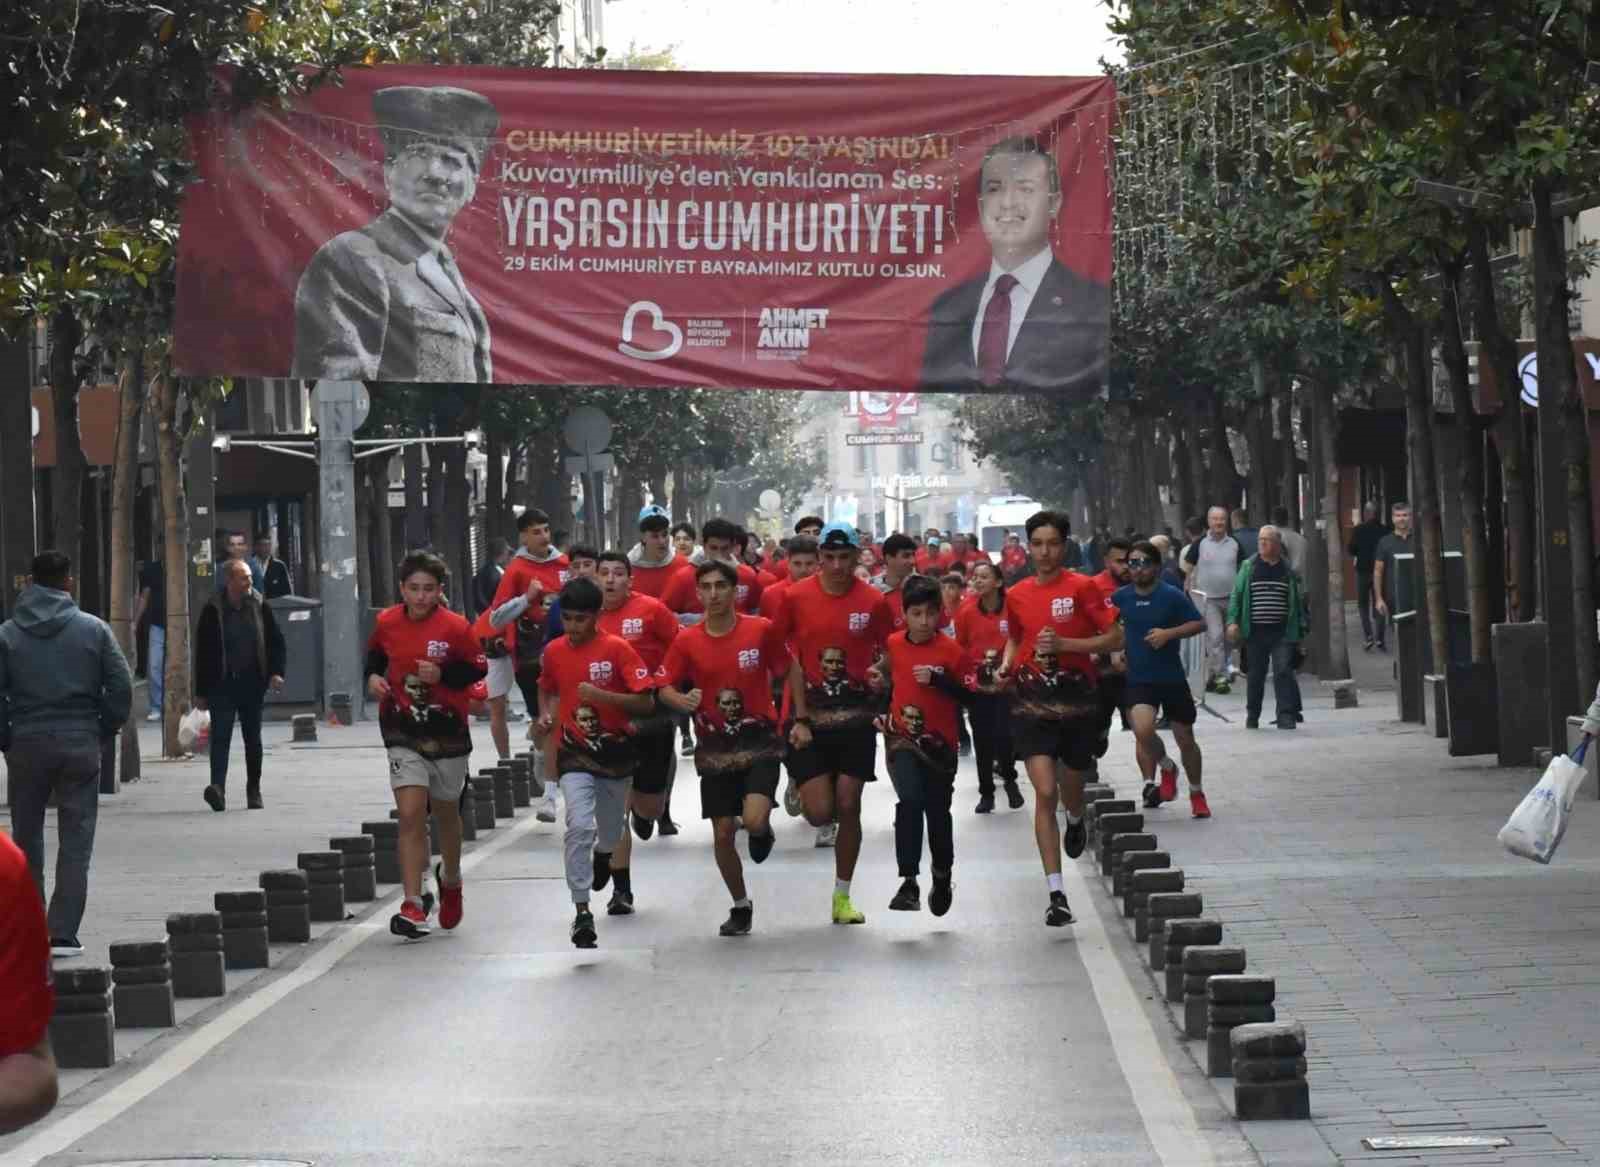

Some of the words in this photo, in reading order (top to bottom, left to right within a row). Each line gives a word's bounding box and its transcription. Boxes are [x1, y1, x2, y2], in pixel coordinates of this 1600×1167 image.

[506, 127, 756, 156] CUMHURİYETİMİZ
[817, 136, 948, 164] YAŞINDA!
[737, 166, 884, 189] Yankılanan
[891, 168, 943, 190] Ses:
[502, 196, 669, 251] YAŞASIN
[677, 193, 944, 254] CUMHURİYET!
[504, 256, 526, 271] 29
[530, 254, 574, 272] EKİM
[579, 256, 697, 274] CUMHURİYET
[701, 260, 813, 277] BAYRAMIMIZ
[818, 262, 875, 277] KUTLU
[880, 263, 946, 279] OLSUN.
[757, 307, 829, 328] AHMET
[756, 327, 809, 348] AKIN
[1052, 597, 1074, 608] 29
